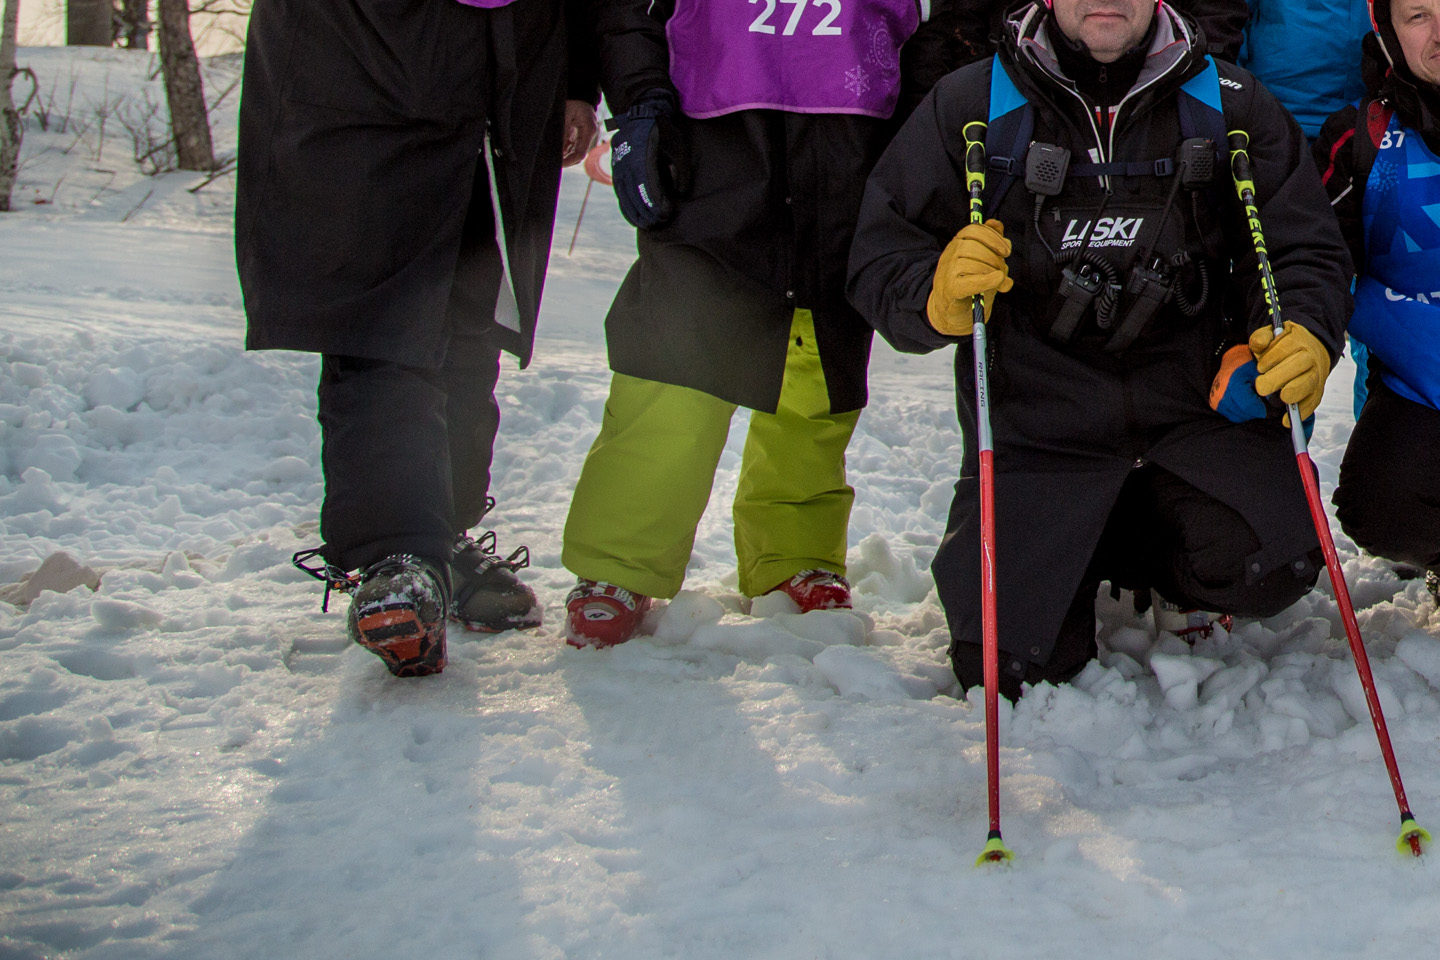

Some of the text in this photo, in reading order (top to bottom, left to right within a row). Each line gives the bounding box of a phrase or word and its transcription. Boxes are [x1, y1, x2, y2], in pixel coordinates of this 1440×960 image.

[970, 198, 983, 225] LE
[1061, 216, 1144, 242] LISKI
[1245, 205, 1268, 255] LEKI
[1060, 239, 1136, 250] SPOR EQUIPMENT
[978, 361, 986, 408] RACING
